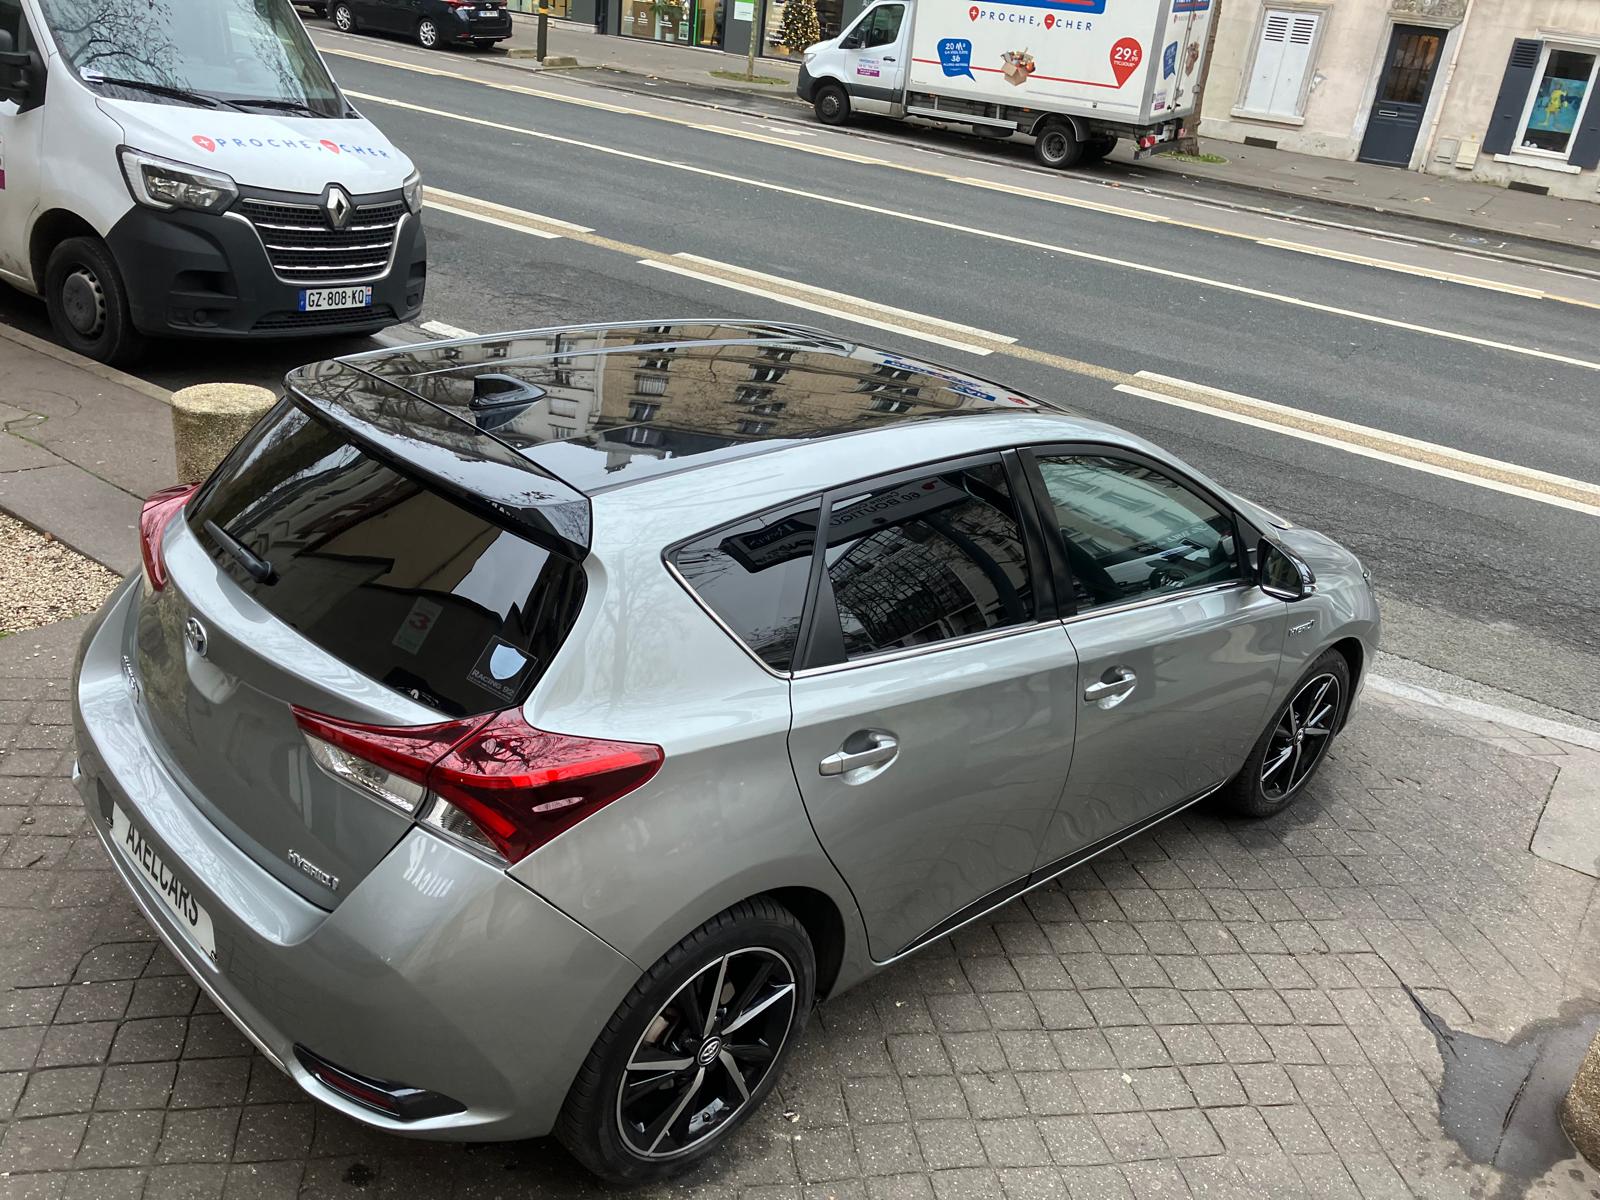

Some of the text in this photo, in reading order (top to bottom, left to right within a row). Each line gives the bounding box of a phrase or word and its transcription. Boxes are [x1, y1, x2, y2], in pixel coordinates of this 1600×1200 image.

[1055, 19, 1093, 31] CHER
[339, 144, 391, 159] CHER
[471, 669, 502, 691] RACING
[502, 685, 515, 697] 92
[126, 824, 199, 927] AXELCARS
